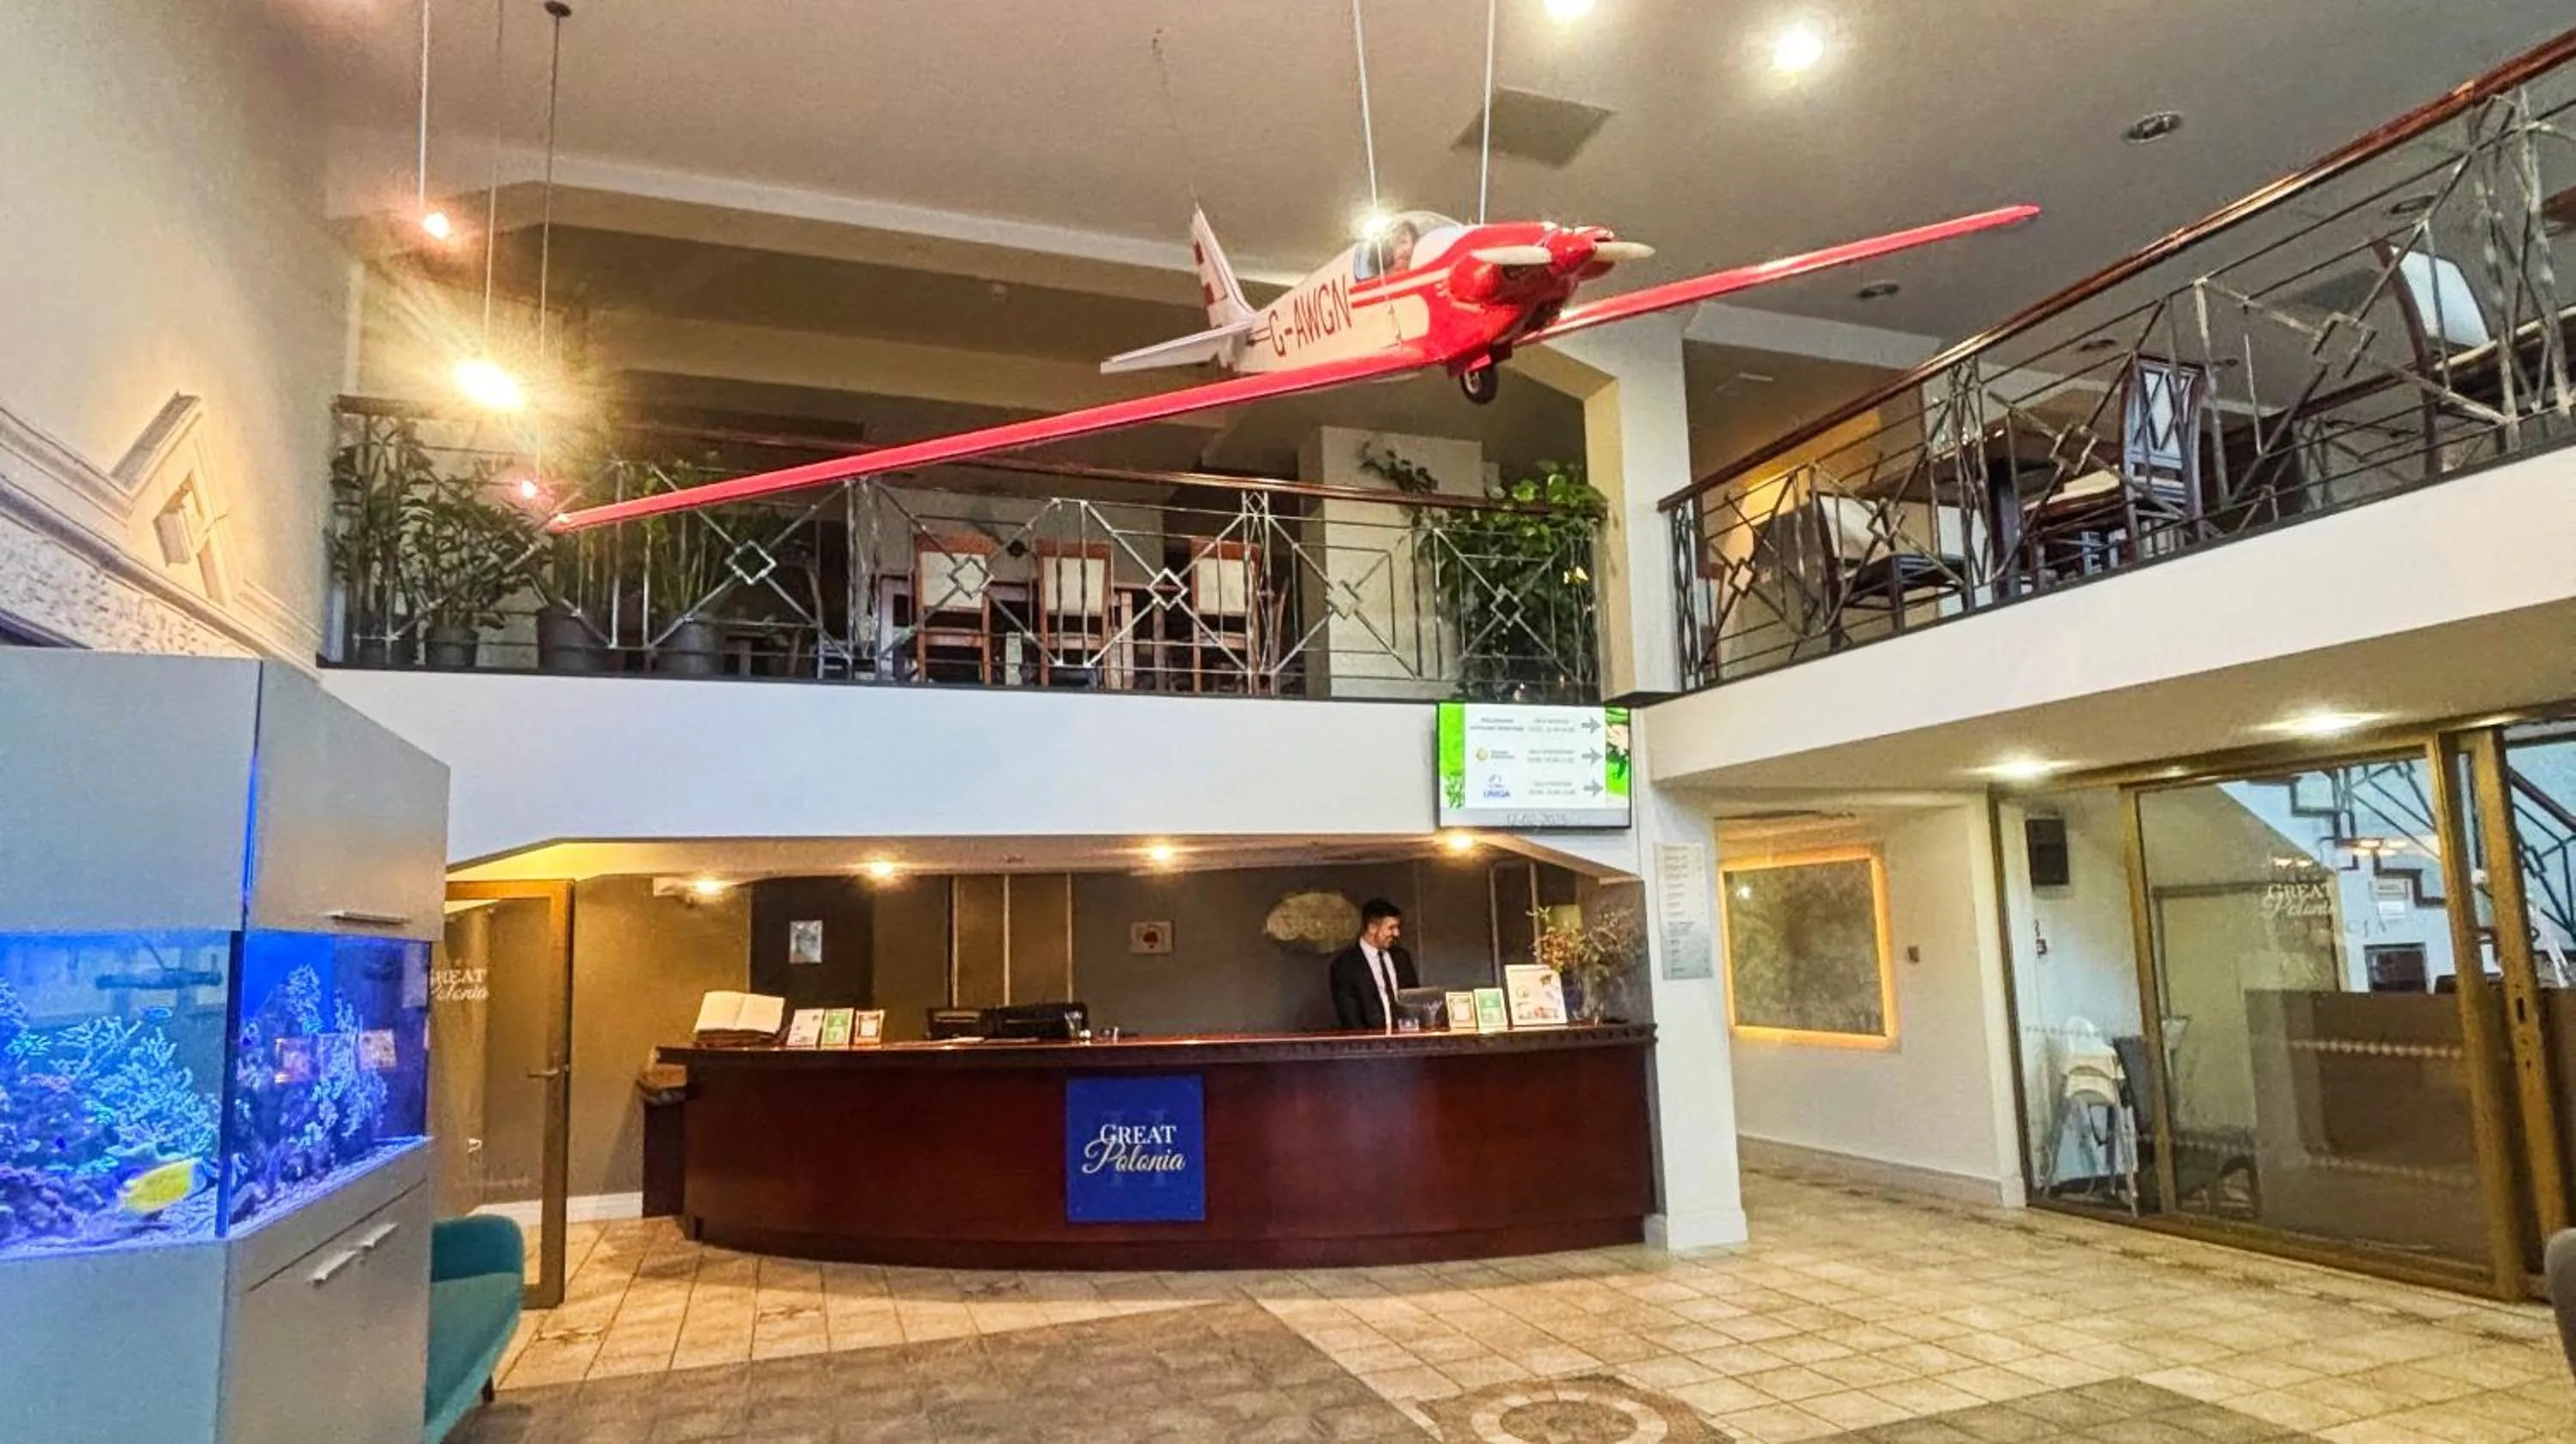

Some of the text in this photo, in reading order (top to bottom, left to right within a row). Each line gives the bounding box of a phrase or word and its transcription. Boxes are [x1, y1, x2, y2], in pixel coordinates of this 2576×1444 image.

[1268, 275, 1352, 357] G-AWGN
[1099, 1123, 1178, 1145] GREAT
[1081, 1138, 1186, 1174] Polonia
